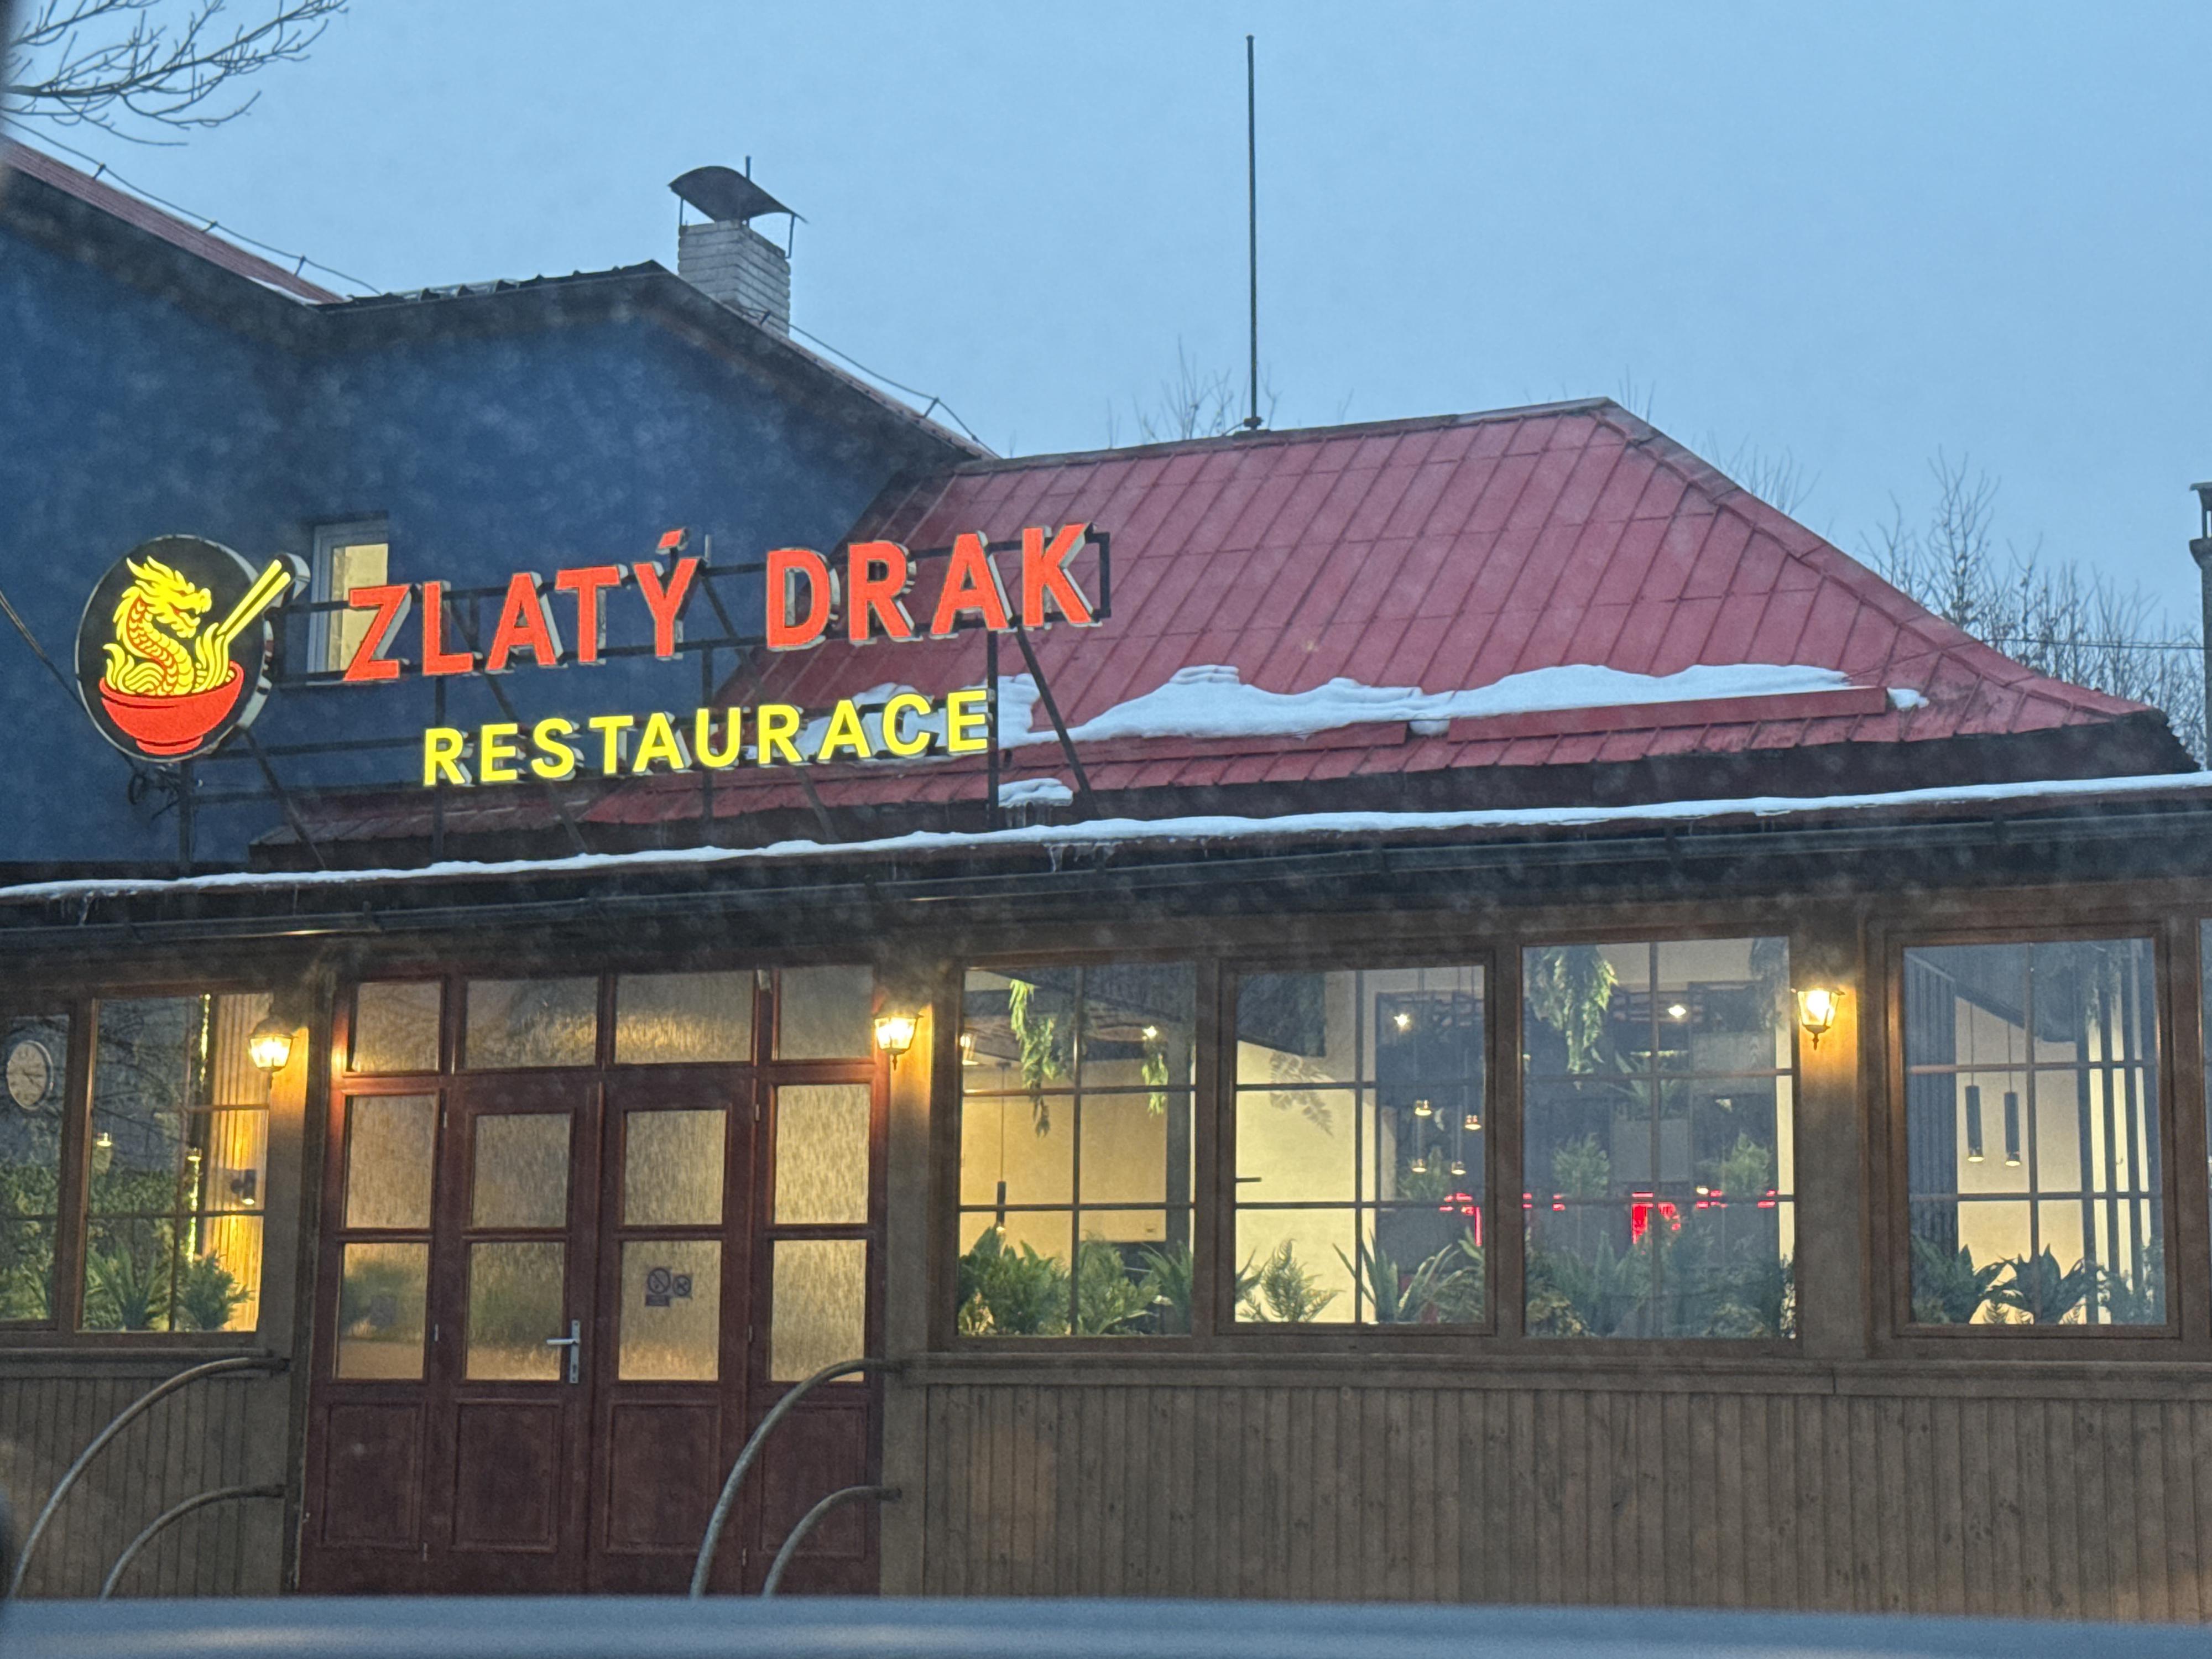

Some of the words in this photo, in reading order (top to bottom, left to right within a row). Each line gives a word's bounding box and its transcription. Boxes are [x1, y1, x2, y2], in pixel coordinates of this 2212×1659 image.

[342, 529, 698, 682] ZLATÝ
[766, 523, 1093, 649] DRAK
[423, 689, 989, 786] RESTAURACE
